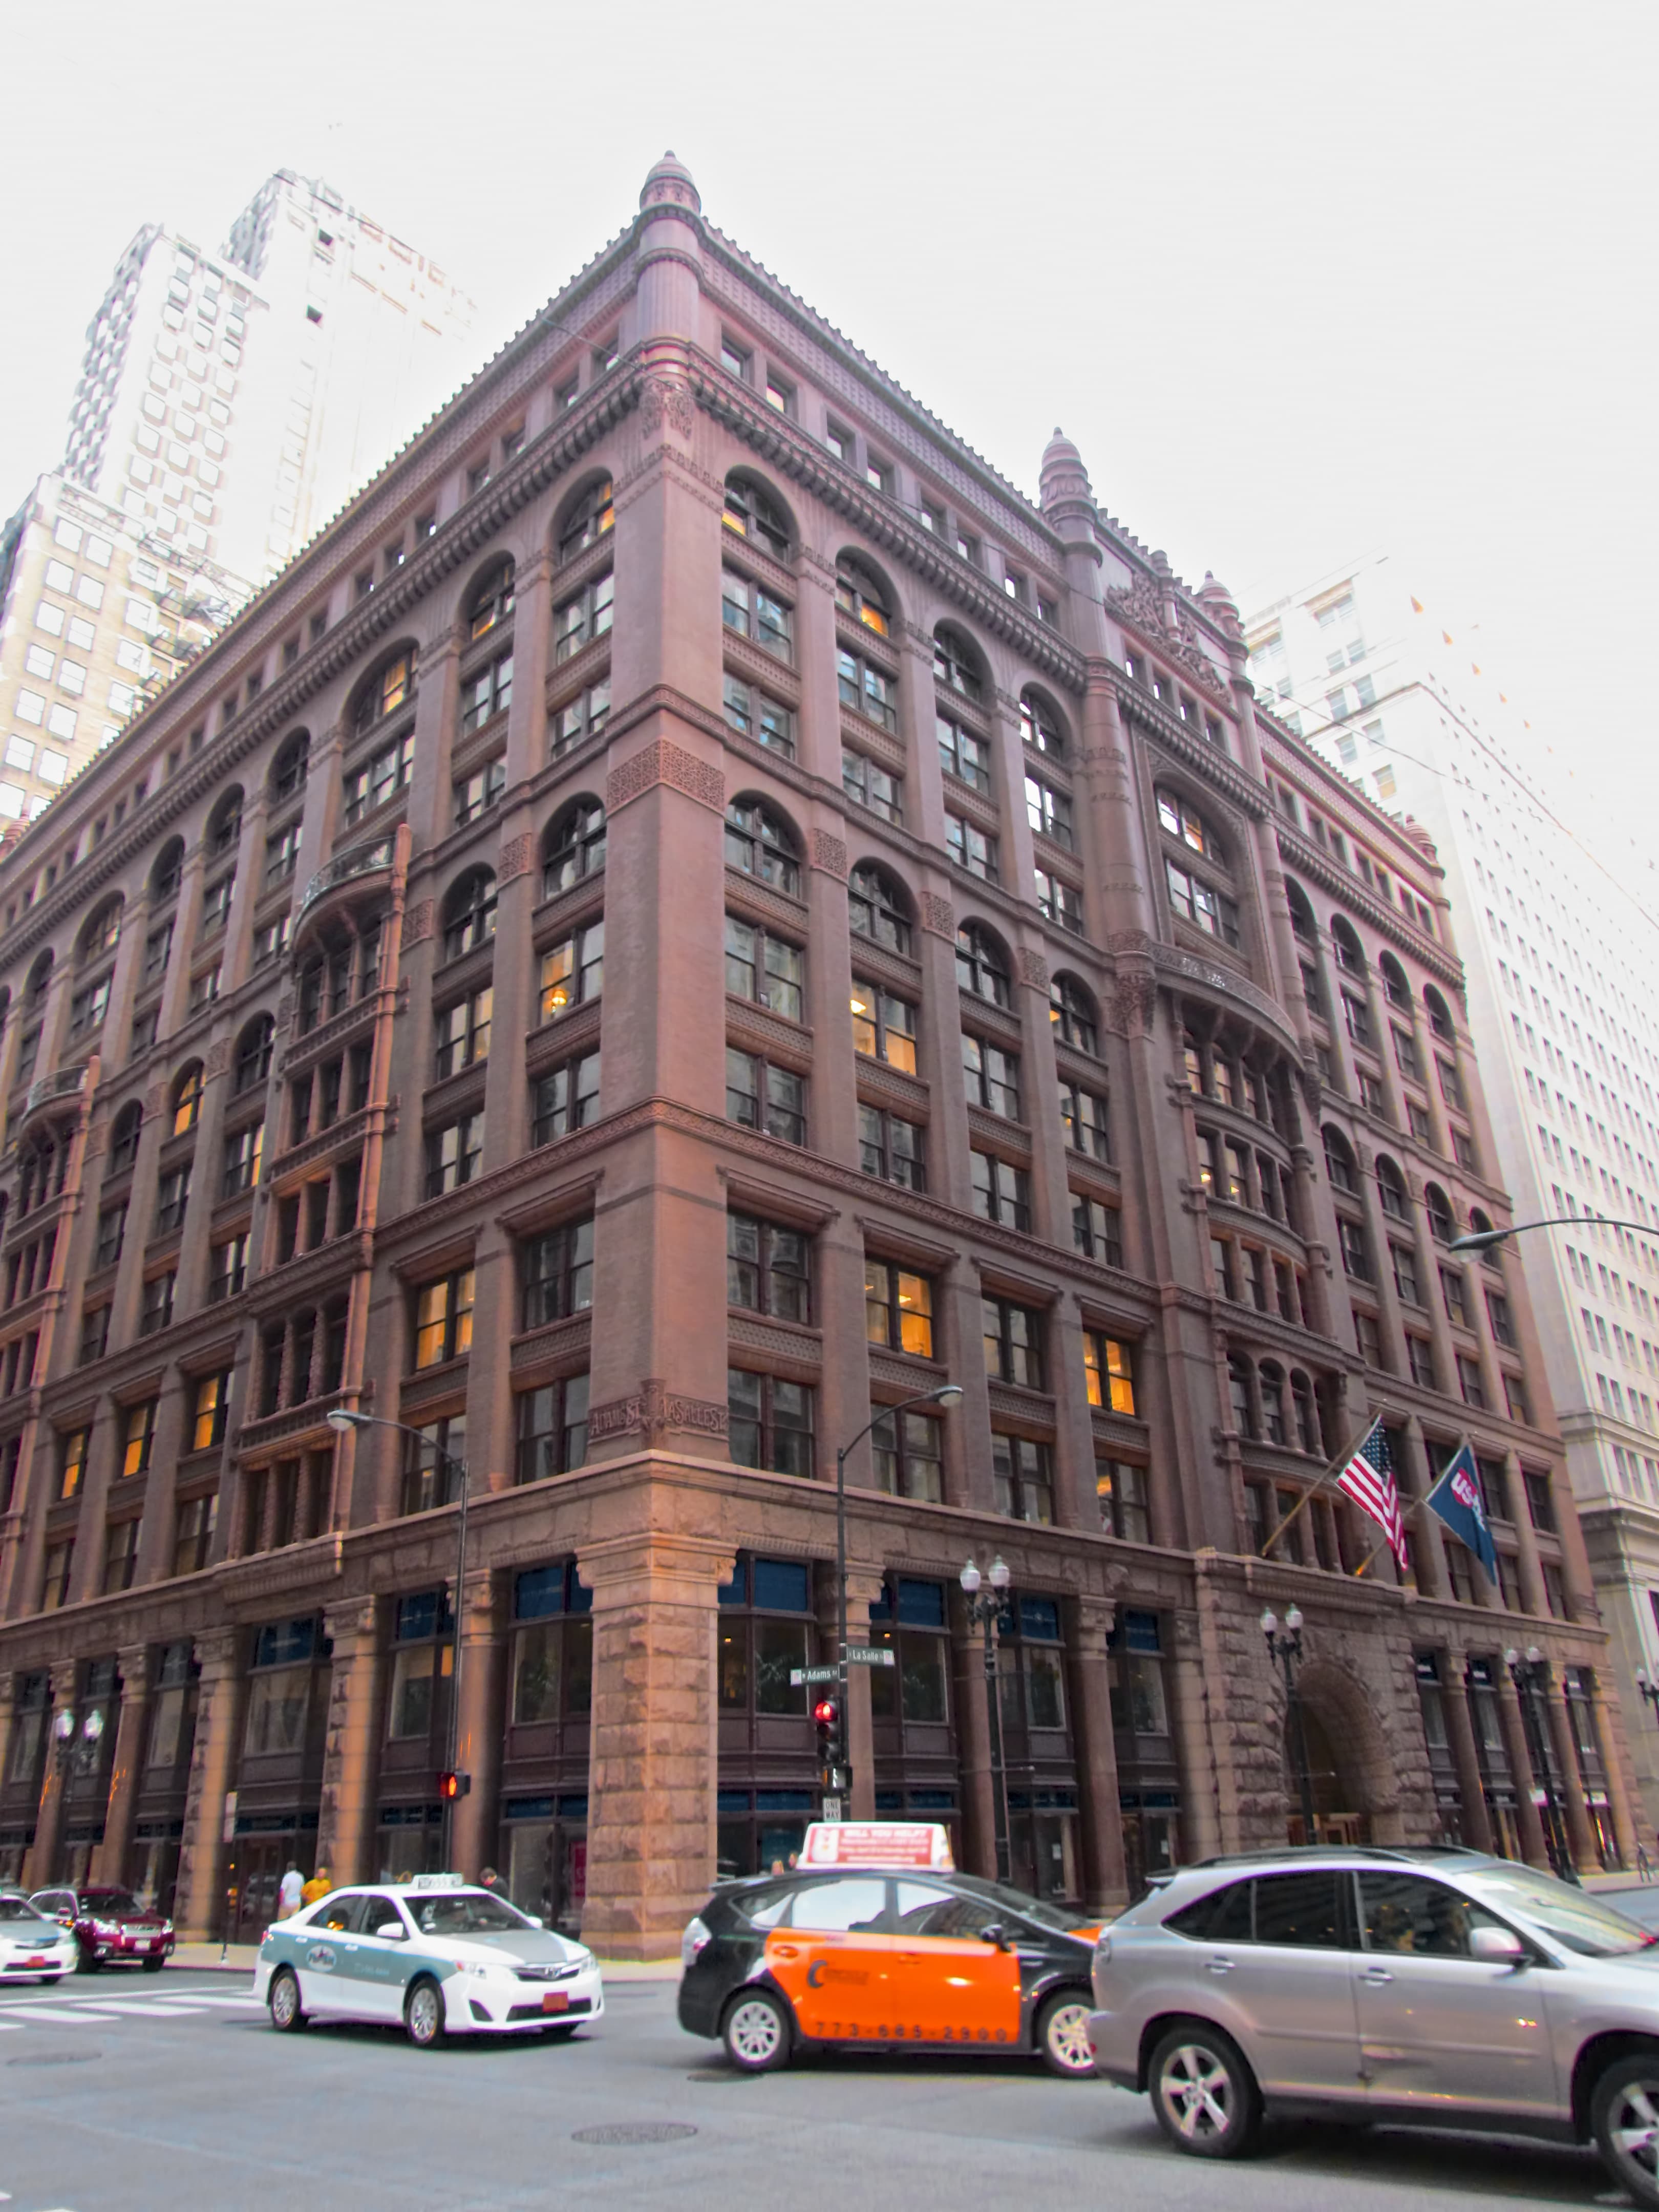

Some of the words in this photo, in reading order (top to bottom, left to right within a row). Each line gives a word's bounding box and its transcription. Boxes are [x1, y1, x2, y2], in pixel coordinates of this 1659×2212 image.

[853, 1649, 861, 1660] La
[862, 1650, 879, 1662] Salle
[807, 1670, 831, 1681] Adams
[825, 1800, 840, 1810] ONE
[825, 1810, 840, 1819] WAY
